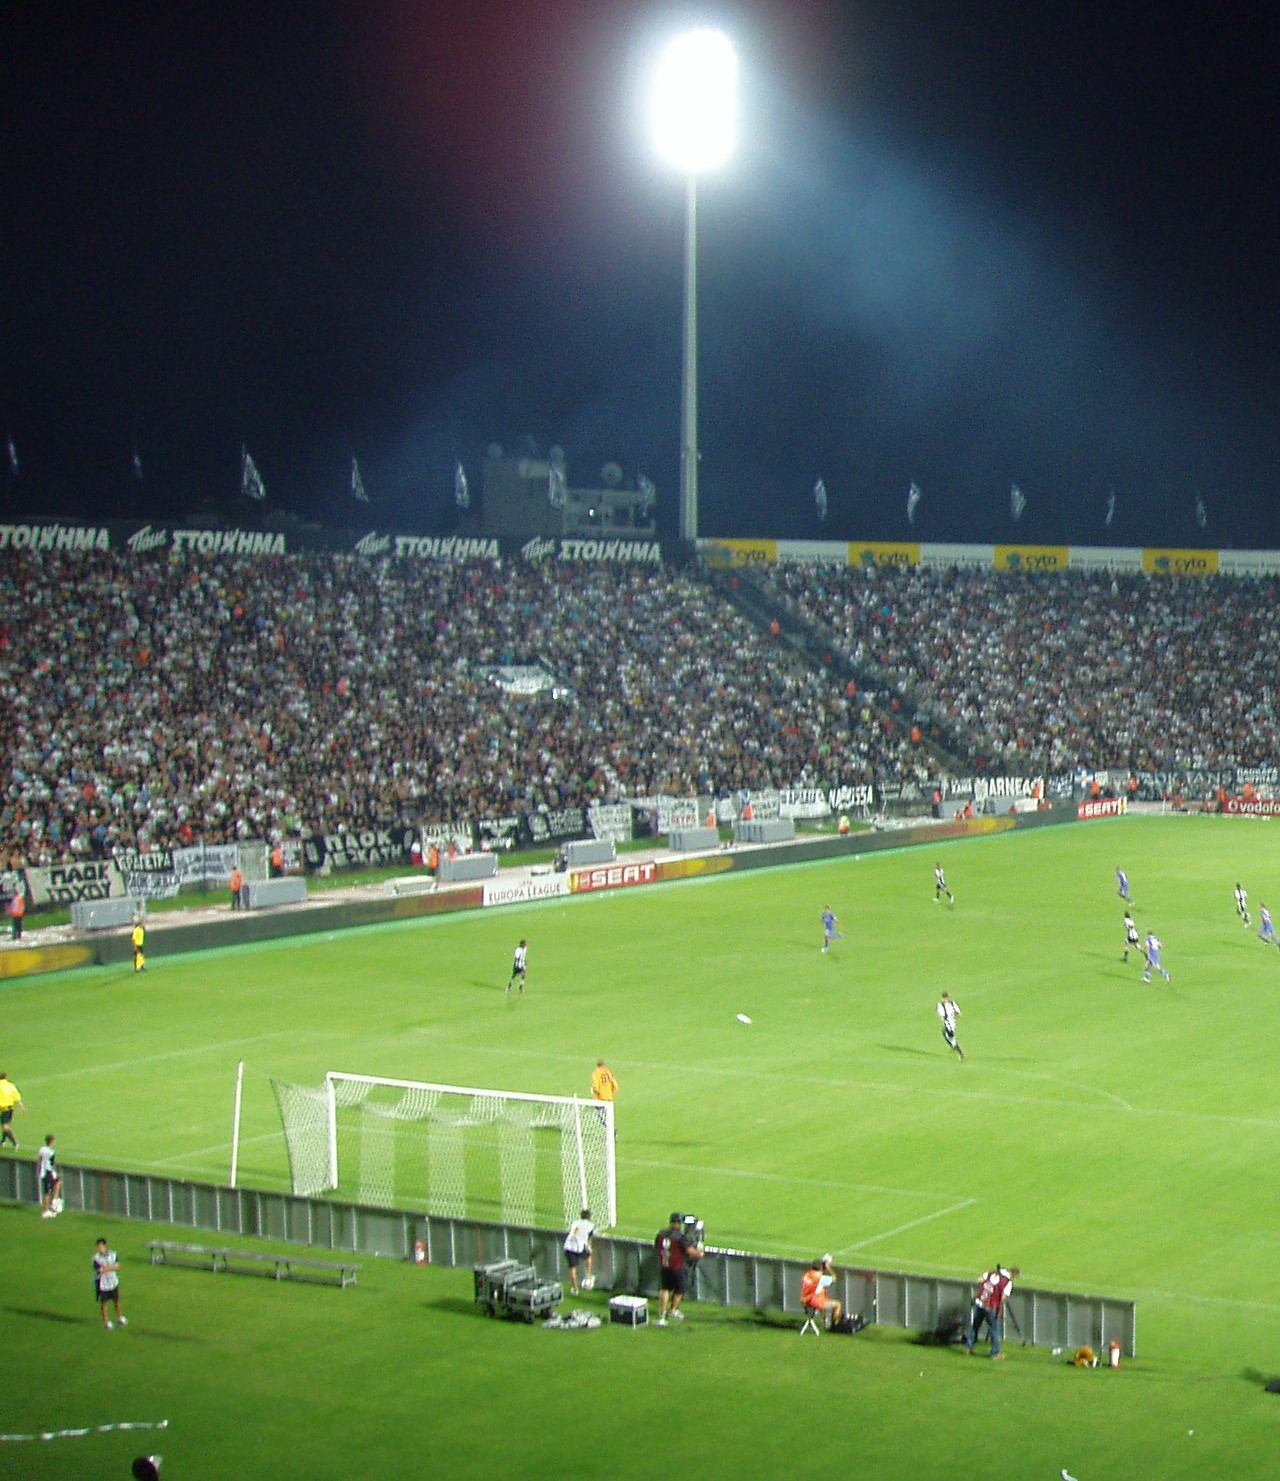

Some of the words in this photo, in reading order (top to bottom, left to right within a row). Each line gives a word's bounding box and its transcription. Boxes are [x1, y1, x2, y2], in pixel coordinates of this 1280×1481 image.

[0, 523, 110, 552] ΤΟΙΧΗΜΑ
[1025, 554, 1057, 568] cyta
[1174, 557, 1207, 571] cyta
[1085, 800, 1118, 816] SEAT
[325, 829, 392, 852] ΠΑΟΚ
[51, 863, 109, 885] ΠΑΟΚ
[591, 863, 655, 888] SEAT
[488, 886, 524, 901] EUROPA
[527, 883, 561, 898] LEAGUE
